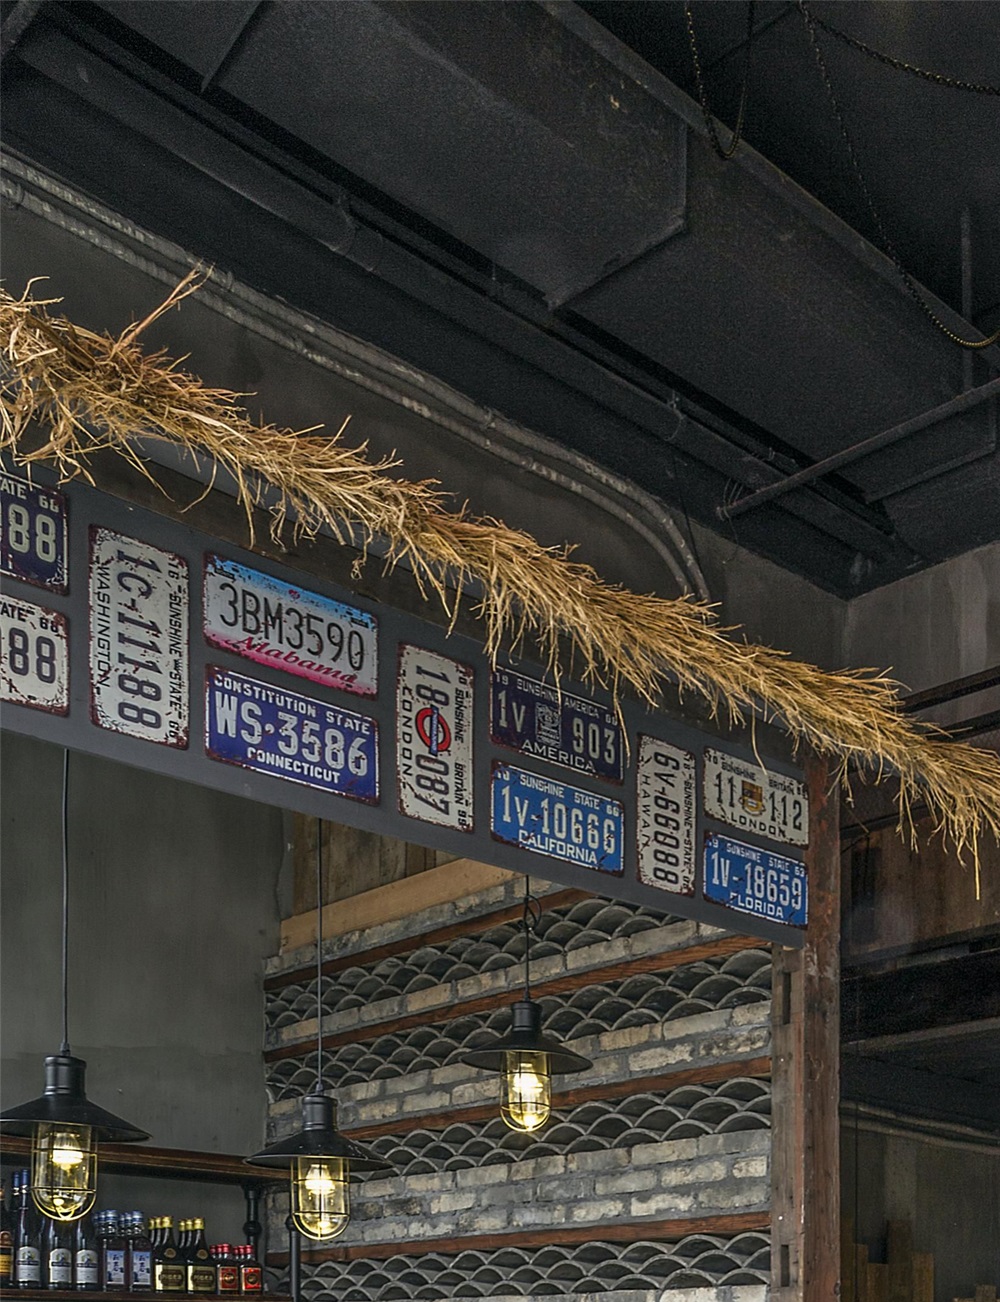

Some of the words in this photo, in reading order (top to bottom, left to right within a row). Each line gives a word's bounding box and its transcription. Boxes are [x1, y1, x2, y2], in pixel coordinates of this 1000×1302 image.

[0, 476, 27, 499] ATE
[0, 602, 27, 623] ATE
[97, 566, 111, 688] WASHINGTON
[168, 593, 183, 657] SUNSHINE
[219, 582, 365, 671] 3BM3590
[117, 549, 163, 729] 1C-11188
[225, 636, 359, 684] Alabama
[168, 670, 183, 712] STATE
[213, 674, 317, 718] CONSTITUTION
[325, 711, 371, 735] STATE
[415, 665, 451, 707] 18
[454, 687, 466, 744] SUNSHINE
[563, 697, 600, 719] AMERICA
[402, 686, 413, 777] LONDON
[572, 717, 616, 765] 903
[246, 747, 342, 784] CONNECTICUT
[521, 739, 597, 773] AMERICA
[415, 753, 451, 816] 087
[454, 762, 465, 805] BRITAIN
[519, 774, 565, 799] SUNSHINE
[574, 792, 600, 810] STATE
[683, 780, 693, 829] SUNSHINE
[501, 785, 616, 855] 1V-10666
[653, 751, 680, 886] 6V-66088
[730, 812, 787, 838] LONDON
[769, 791, 803, 831] 112
[518, 829, 598, 865] CALIFORNIA
[683, 838, 693, 870] STATE
[726, 843, 762, 863] SUNSHINE
[768, 857, 790, 873] STATE
[711, 852, 802, 910] 1V-18659
[729, 891, 785, 919] FLORIDA
